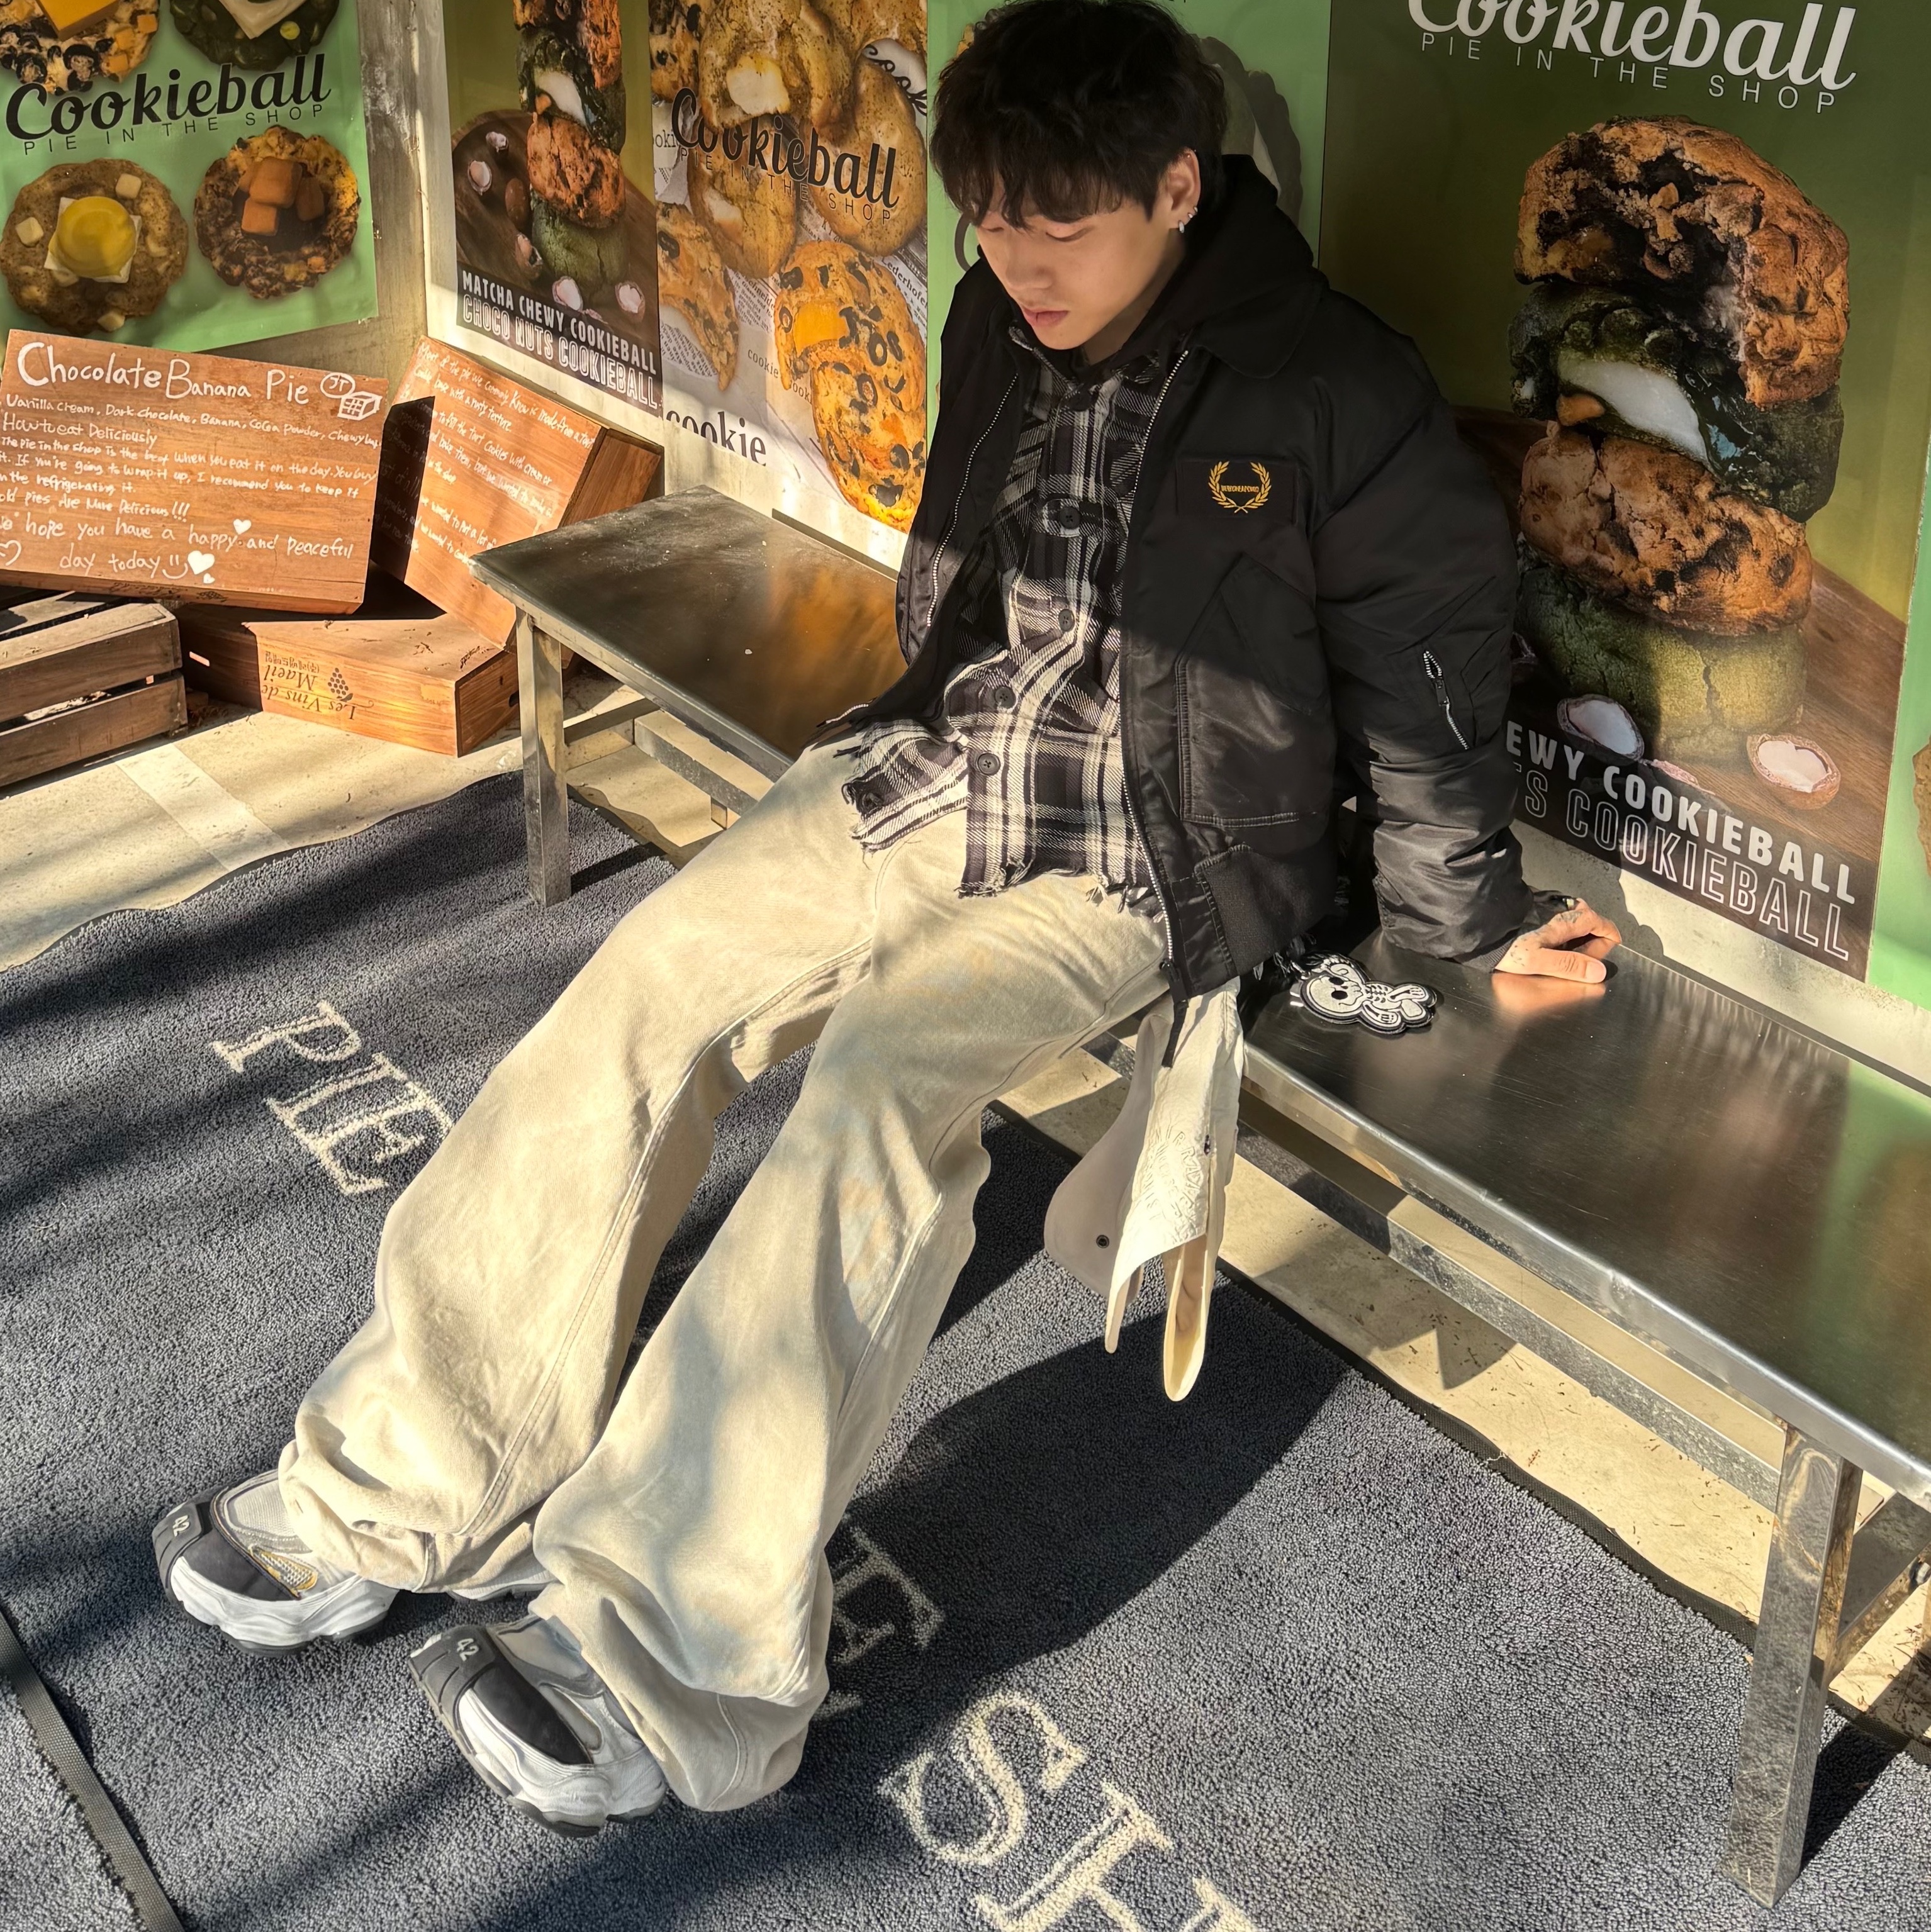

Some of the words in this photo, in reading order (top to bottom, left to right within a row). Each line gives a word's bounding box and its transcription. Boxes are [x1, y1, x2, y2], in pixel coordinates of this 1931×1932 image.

[1421, 33, 1482, 60] PIE
[1516, 47, 1553, 70] IN
[1590, 56, 1669, 90] THE
[1708, 74, 1837, 114] SHOP
[6, 53, 332, 141] Cookieball
[25, 135, 77, 155] PIE
[106, 129, 135, 144] IN
[163, 117, 218, 137] THE
[246, 104, 323, 126] SHOP
[671, 87, 899, 209] Cookieball
[680, 147, 714, 171] PIE
[730, 164, 750, 182] IN
[768, 174, 808, 201] THE
[829, 193, 890, 225] SHOP
[462, 270, 514, 311] MATCHA
[519, 295, 564, 332] CHEWY
[570, 318, 657, 375] COOKIEBALL
[463, 294, 510, 340] CHOCO
[515, 316, 553, 359] NUTS
[559, 336, 658, 410] COOKIEBALL
[747, 349, 778, 378] cookie
[18, 342, 162, 389] Chocolate
[165, 359, 251, 399] Banana
[266, 369, 309, 405] Pie
[106, 404, 134, 416] Dark
[3, 412, 39, 432] How
[57, 423, 84, 437] eat
[89, 423, 157, 449] Deliciously
[15, 454, 30, 466] If
[75, 461, 103, 475] going
[108, 463, 120, 476] to
[197, 472, 206, 482] I
[275, 481, 293, 493] you
[299, 483, 311, 493] to
[53, 439, 69, 451] the
[72, 442, 102, 455] shop
[105, 445, 116, 457] is
[120, 449, 138, 460] the
[255, 461, 266, 472] it
[271, 464, 283, 472] on
[289, 463, 308, 475] the
[0, 487, 18, 503] old
[77, 523, 104, 540] you
[115, 517, 153, 539] have
[161, 528, 176, 540] a
[188, 523, 238, 552] happy
[247, 534, 279, 549] and
[60, 542, 96, 576] day
[108, 550, 160, 578] today
[261, 684, 279, 701] de
[263, 664, 318, 692] Maeil
[284, 690, 322, 713] Vins
[328, 701, 356, 720] Les
[1506, 720, 1584, 781] EWY
[1604, 765, 1855, 905] COOKIEBALL
[1566, 788, 1850, 962] COOKIEBALL
[211, 1000, 454, 1195] PIE
[172, 1515, 190, 1537] 42
[456, 1637, 479, 1661] 42
